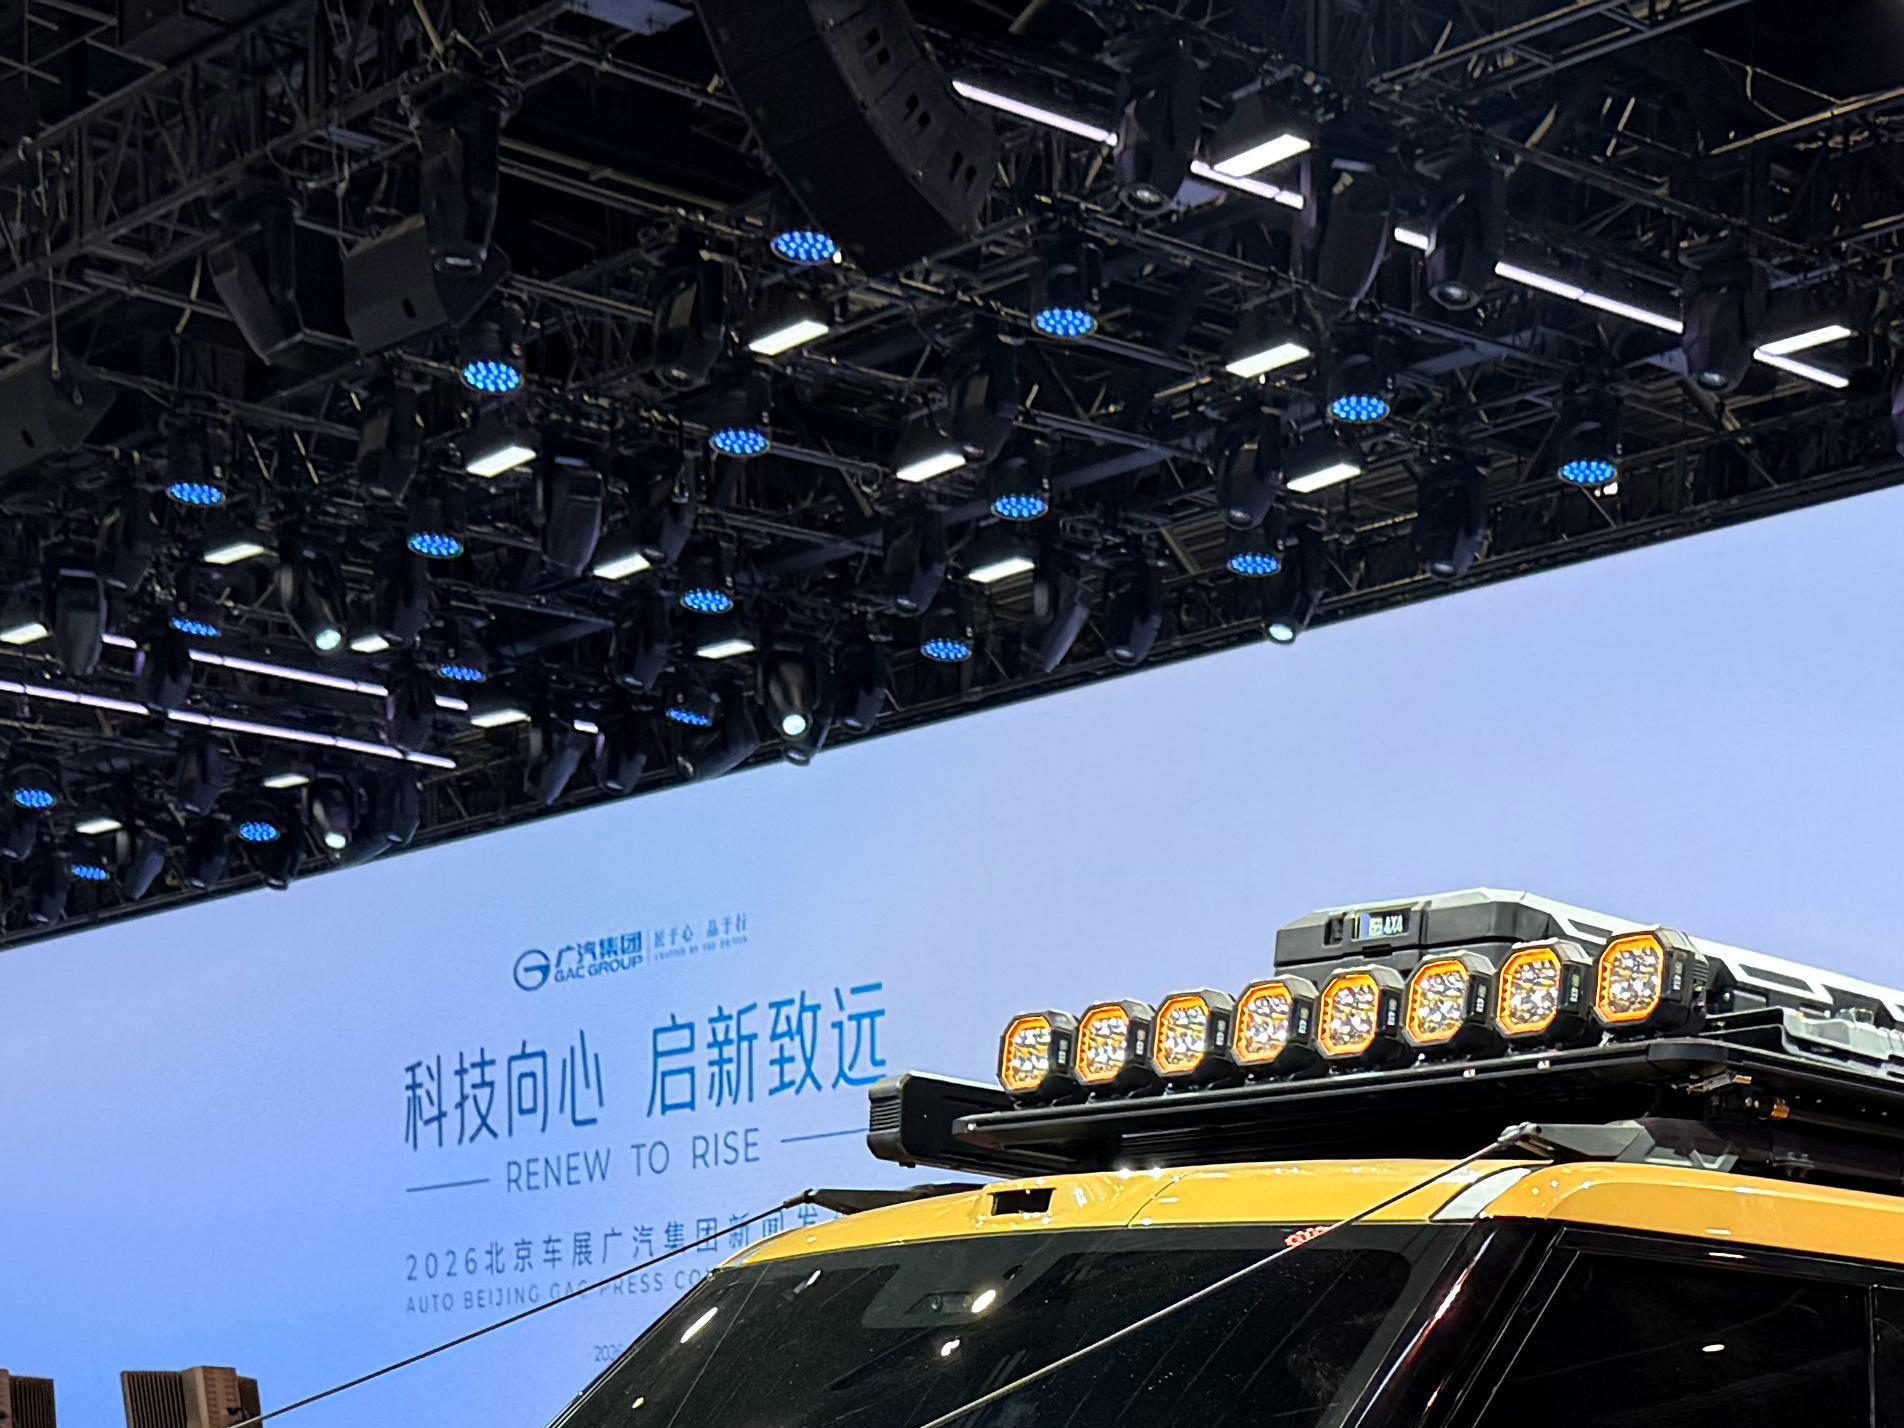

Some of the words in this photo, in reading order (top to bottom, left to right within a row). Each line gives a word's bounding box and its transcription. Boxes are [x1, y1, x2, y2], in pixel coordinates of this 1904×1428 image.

[554, 930, 642, 968] 广汽集团
[554, 966, 586, 983] GAC
[588, 954, 643, 977] GROUP
[404, 1028, 606, 1153] 科技向心
[646, 981, 888, 1120] 启新致远
[505, 1147, 612, 1194] RENEW
[630, 1140, 671, 1177] TO
[693, 1127, 761, 1170] RISE
[405, 1291, 455, 1315] AUTO
[463, 1281, 541, 1310] BEIJING
